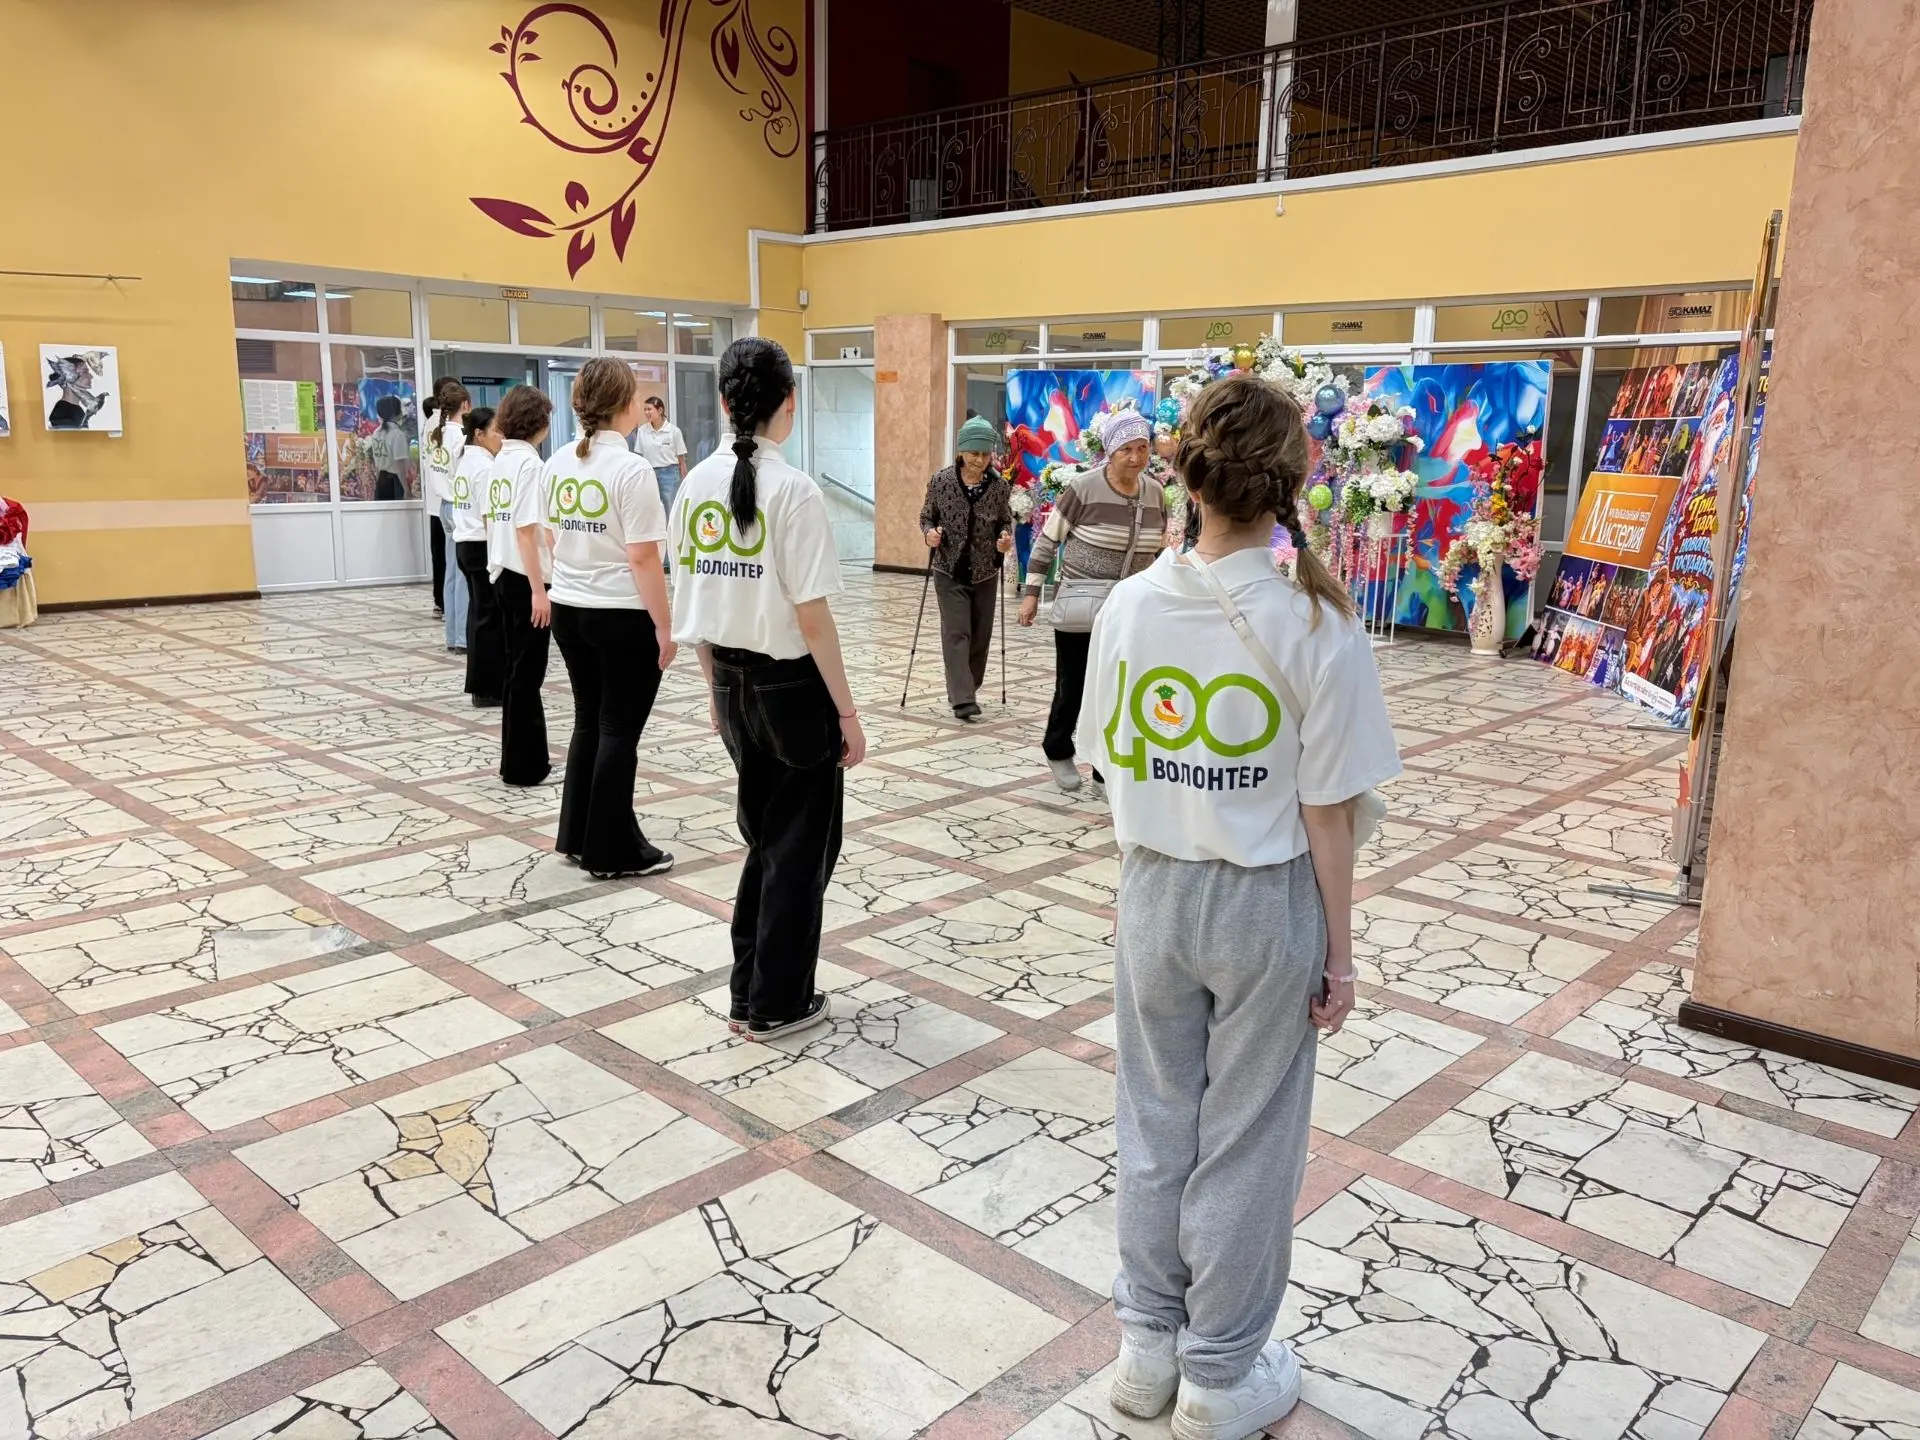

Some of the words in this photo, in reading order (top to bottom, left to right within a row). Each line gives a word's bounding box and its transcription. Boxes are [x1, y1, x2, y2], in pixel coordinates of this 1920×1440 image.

[503, 290, 527, 298] ВЫХОД
[1205, 321, 1234, 341] 400
[1491, 309, 1529, 332] 400
[547, 474, 608, 531] 400
[676, 498, 767, 575] 400
[1581, 492, 1646, 556] Мистерия
[696, 559, 764, 579] ВОЛОНТЕР
[1103, 660, 1282, 782] 400
[1152, 757, 1269, 791] ВОЛОНТЕР
